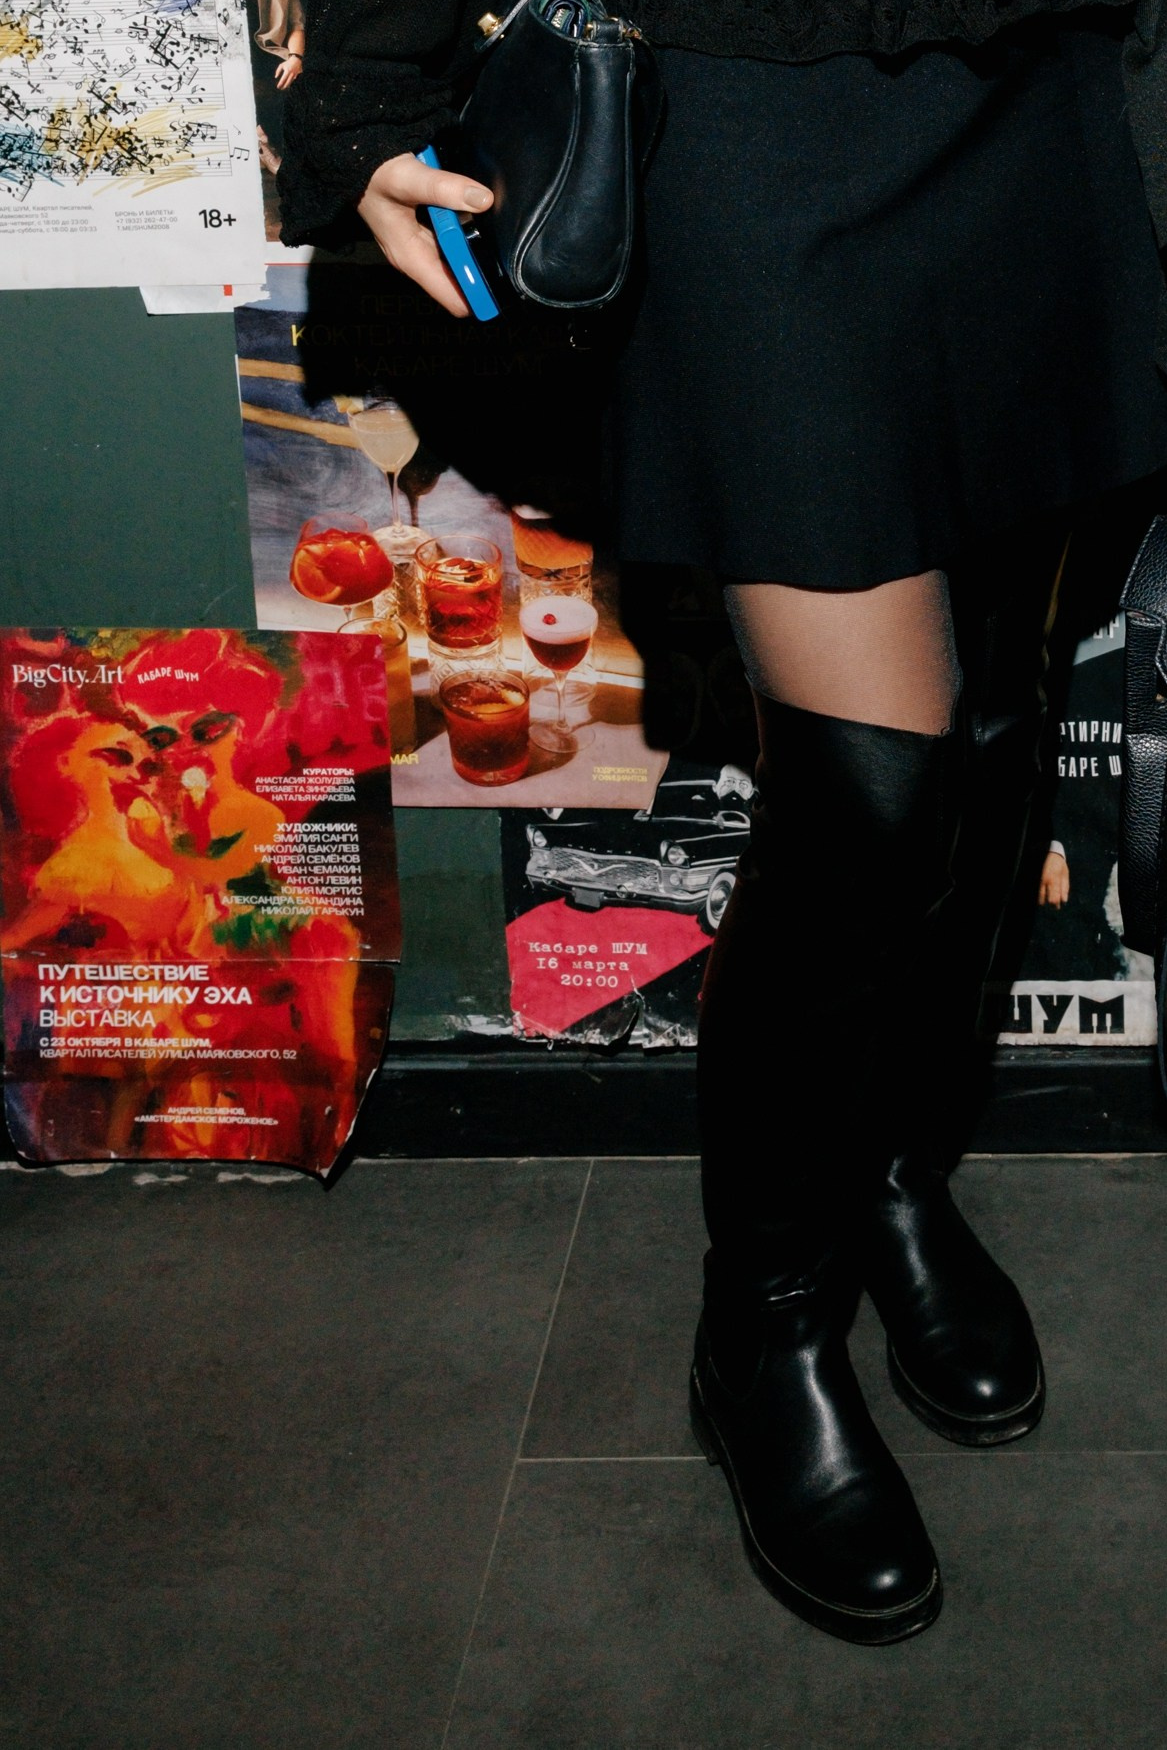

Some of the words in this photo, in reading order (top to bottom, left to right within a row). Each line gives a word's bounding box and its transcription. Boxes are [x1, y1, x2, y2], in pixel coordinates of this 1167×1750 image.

[198, 208, 236, 229] 18+
[12, 664, 126, 688] BigCity.Art
[137, 666, 172, 684] КАБАРЕ
[174, 669, 199, 682] ШУМ
[303, 768, 354, 776] КУРАТОРЫ:
[255, 777, 306, 785] АНАСТАСИЯ
[307, 777, 355, 785] ЖОЛУДЕВА
[256, 785, 304, 793] ЕЛИЗАВЕТА
[277, 823, 357, 833] ХУДОЖНИКИ:
[273, 834, 320, 843] ЭМИЛИЯ
[322, 834, 358, 842] САНГИ
[254, 843, 307, 853] НИКОЛАЙ
[308, 844, 359, 853] БАКУЛЕВ
[261, 854, 305, 864] АНДРЕЙ
[277, 865, 307, 874] ИВАН
[309, 865, 361, 874] ЧЕМАКИН
[286, 876, 324, 884] АНТОН
[325, 876, 362, 884] ЛЕВИН
[281, 886, 314, 895] ЮЛИЯ
[315, 886, 362, 895] МОРТИС
[222, 895, 294, 906] АЛЕКСАНДРА
[296, 896, 363, 906] БАЛАНДИНА
[261, 905, 314, 915] НИКОЛАЙ
[315, 906, 364, 916] ГАРЬКУН
[528, 942, 598, 955] Кабаре
[612, 942, 647, 955] ШУМ
[572, 960, 629, 972] марта
[38, 964, 209, 981] ПУТЕШЕСТВИЕ
[560, 974, 618, 988] 20:00
[40, 986, 56, 1003] К
[60, 985, 199, 1005] ИСТОЧНИКУ
[203, 986, 252, 1005] ЭХА
[40, 1010, 156, 1028] ВЫСТАВКА
[40, 1037, 49, 1047] С
[50, 1037, 66, 1047] 23
[67, 1037, 120, 1047] ОКТЯБРЯ
[133, 1038, 180, 1047] КАБАРЕ
[40, 1049, 91, 1058] КВАРТАЛ
[92, 1048, 156, 1059] ПИСАТЕЛЕЙ
[158, 1050, 195, 1060] УЛИЦА
[196, 1050, 281, 1060] МАЯКОВСКОГО,
[282, 1050, 297, 1059] 52
